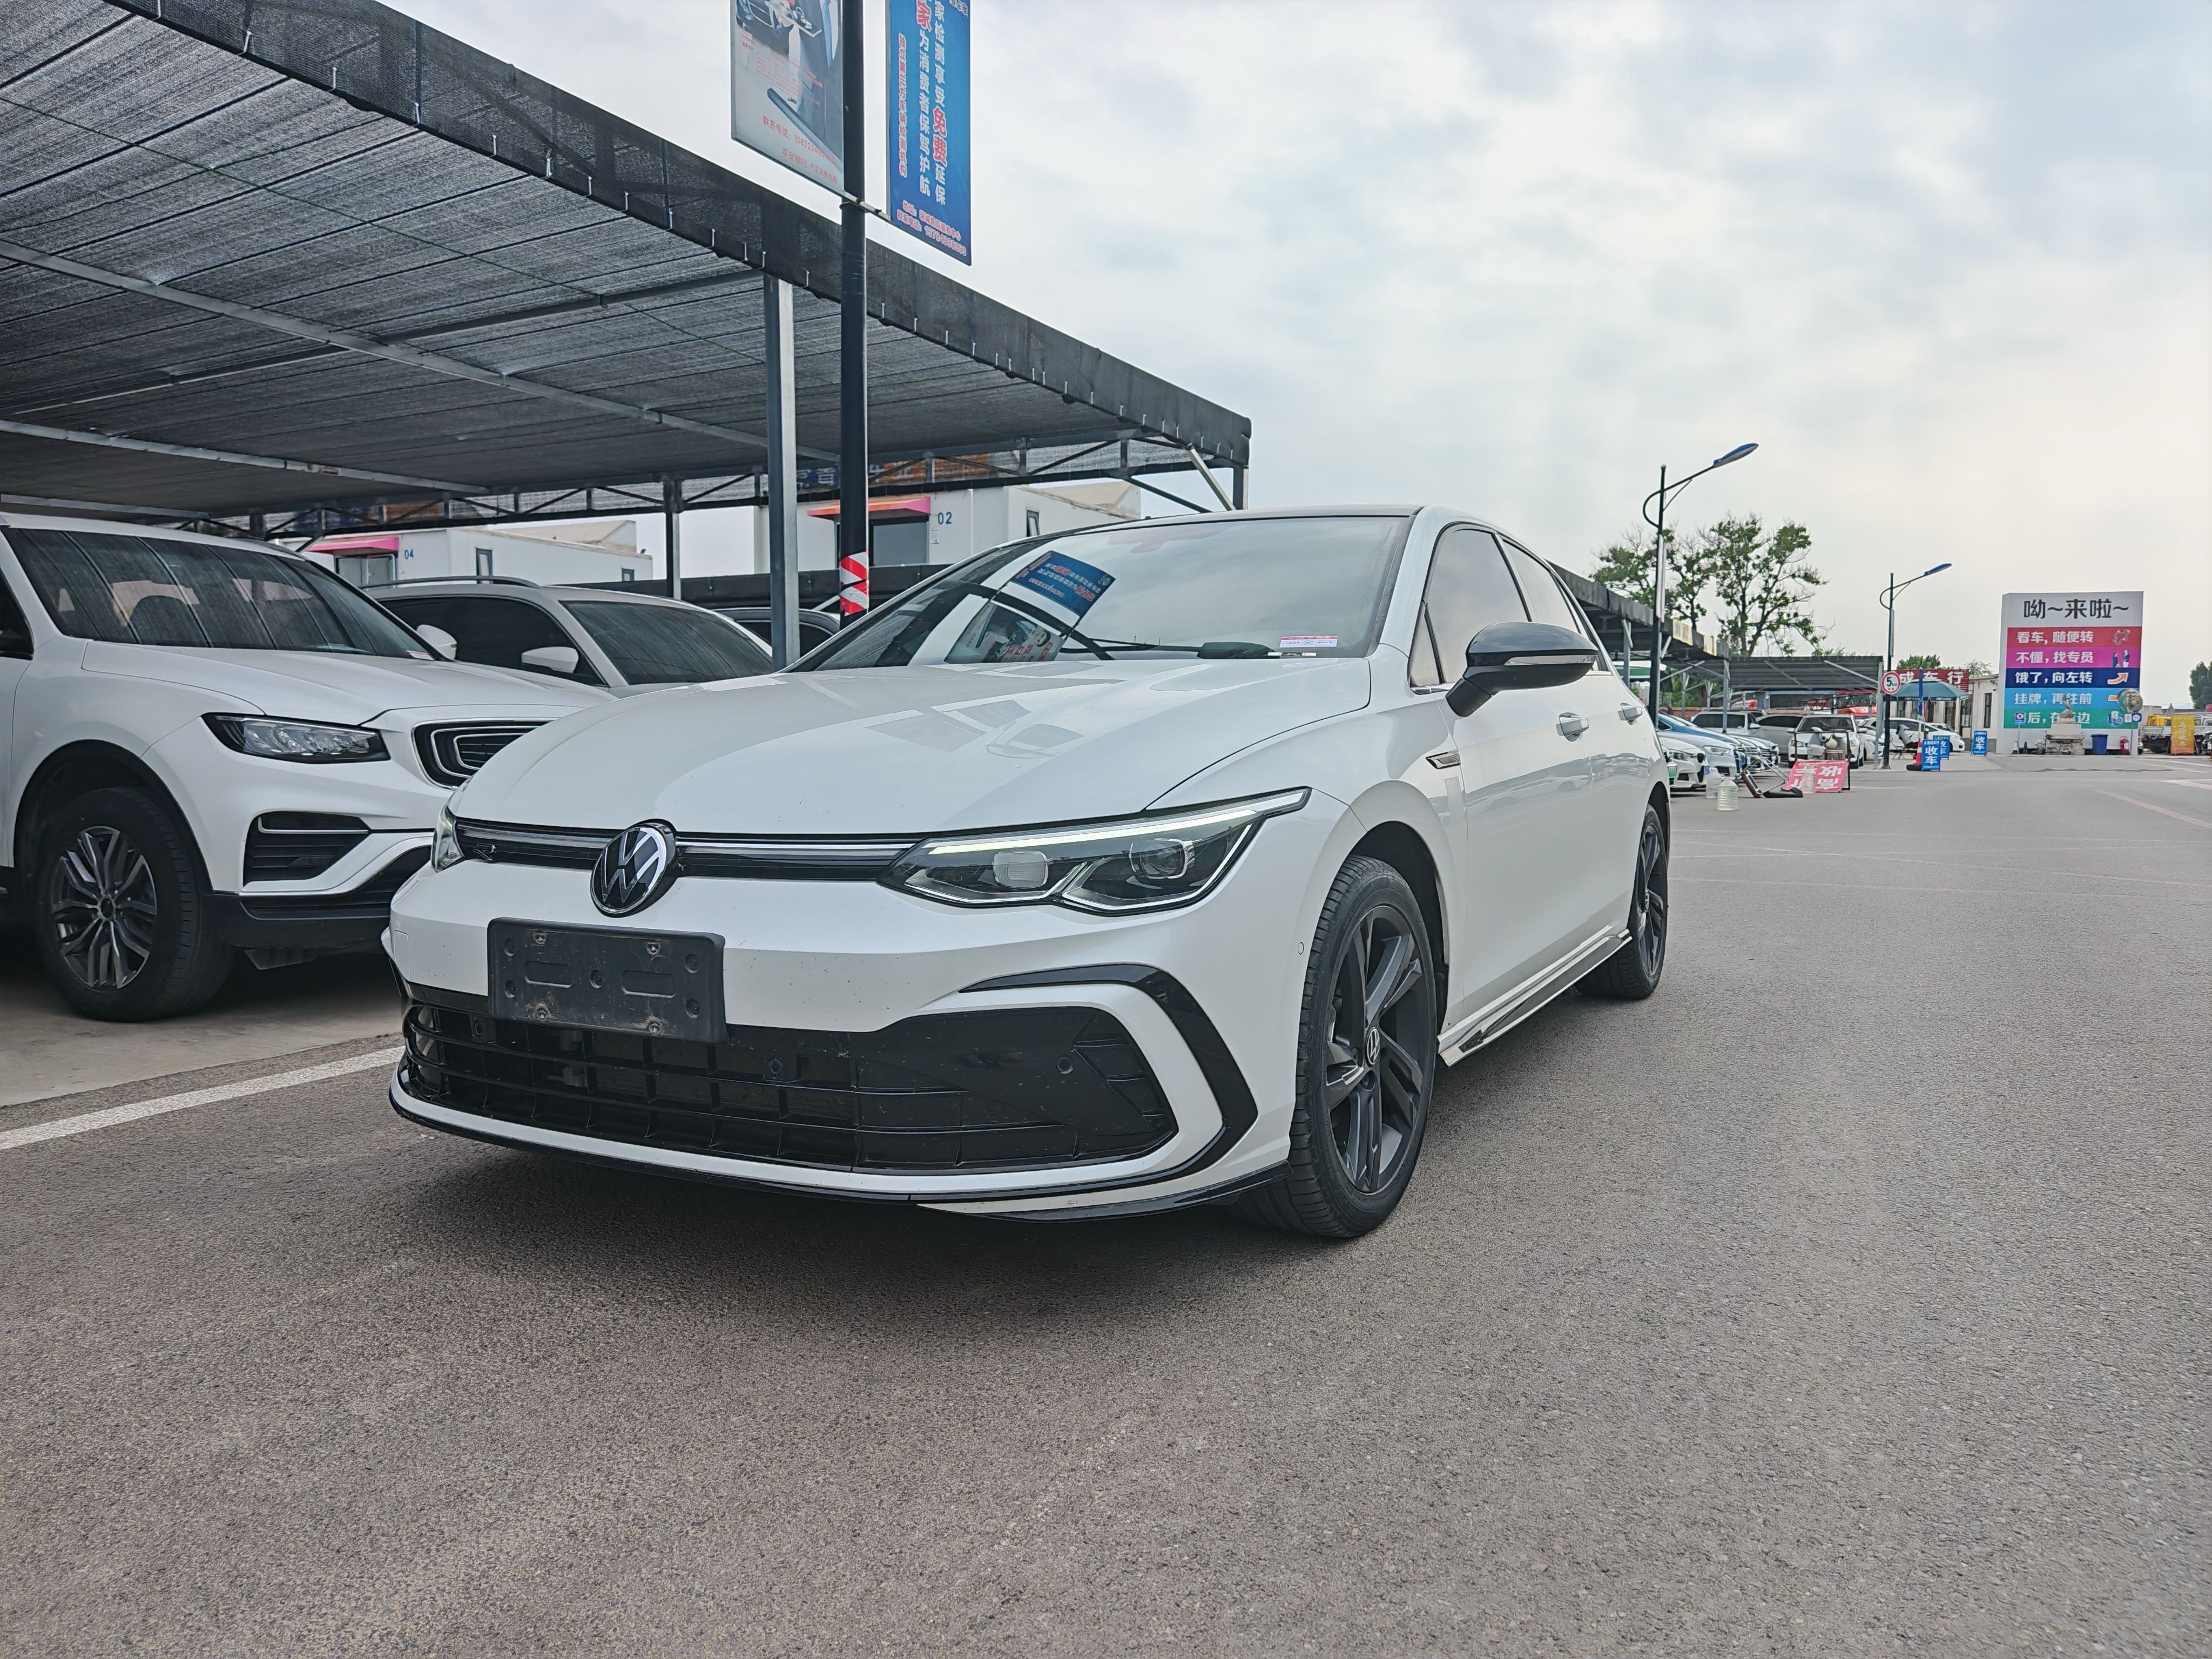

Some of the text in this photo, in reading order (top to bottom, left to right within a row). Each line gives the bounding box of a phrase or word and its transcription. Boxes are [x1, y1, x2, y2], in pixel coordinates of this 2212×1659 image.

[938, 511, 952, 525] 02
[404, 549, 414, 559] 04
[1974, 736, 1985, 751] 收车
[1924, 746, 1939, 765] 收车
